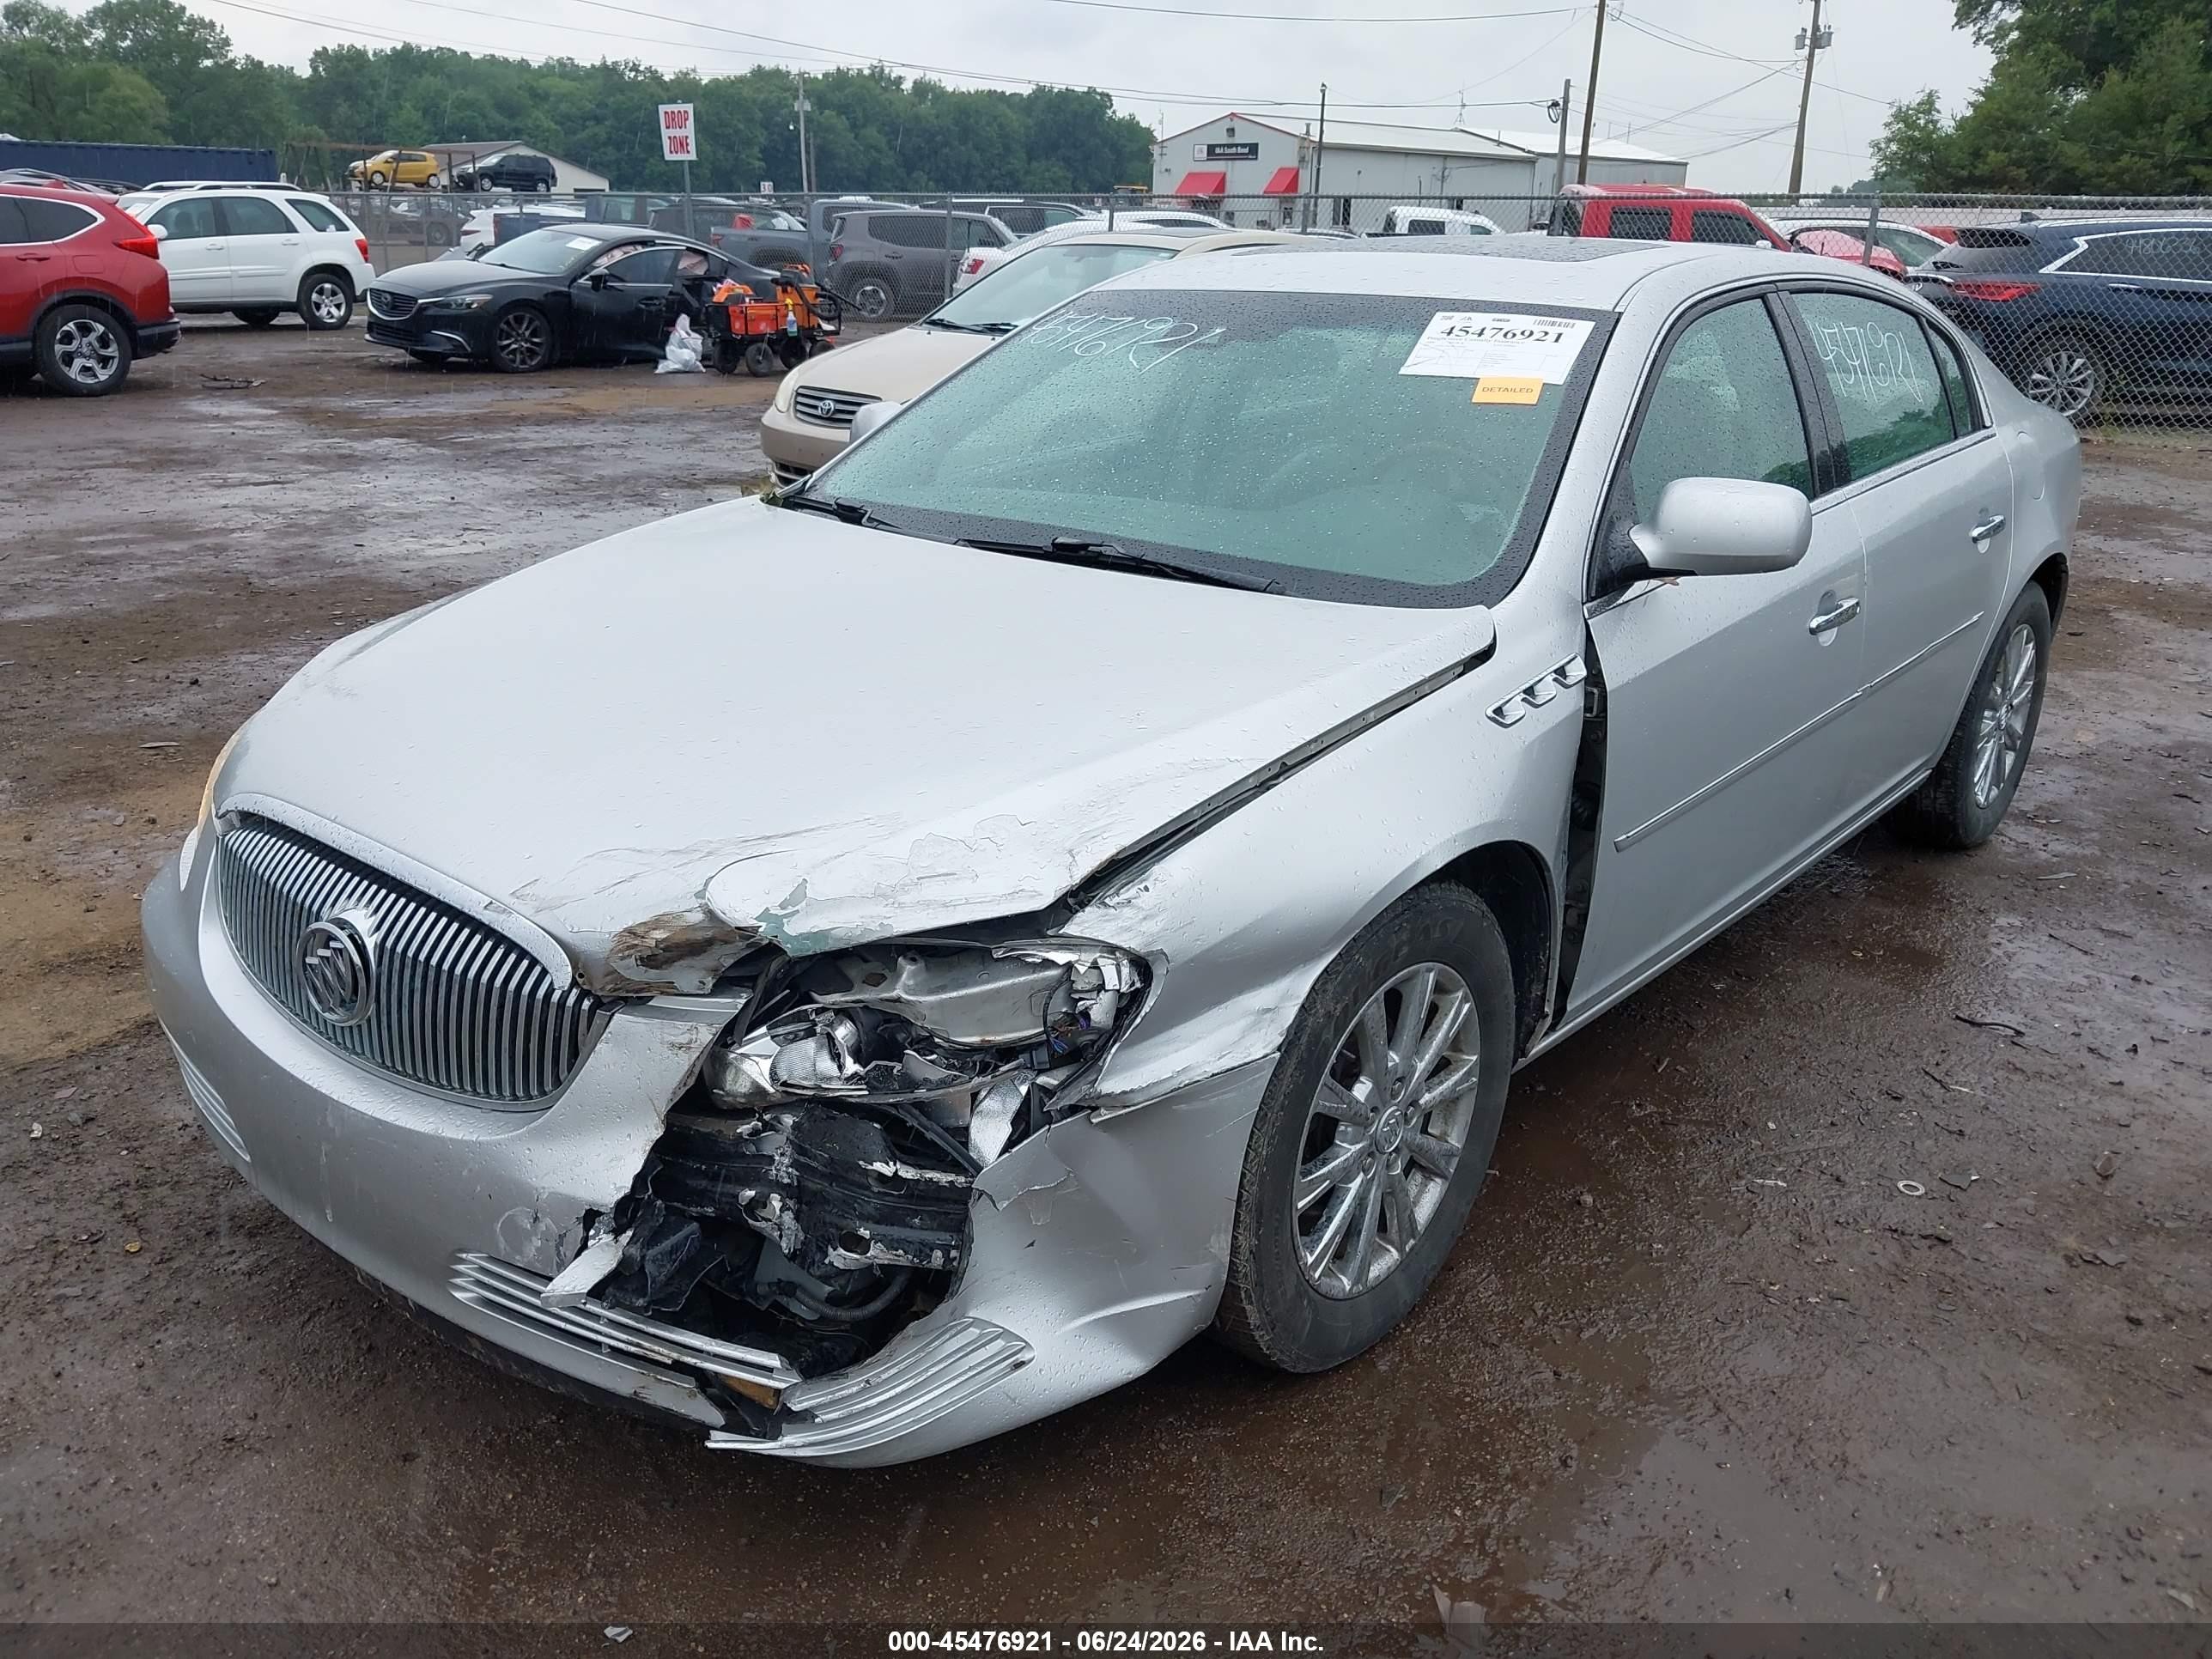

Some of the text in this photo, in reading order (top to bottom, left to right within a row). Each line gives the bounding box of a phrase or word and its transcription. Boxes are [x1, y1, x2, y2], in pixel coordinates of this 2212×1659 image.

[664, 110, 689, 130] DROP
[668, 136, 690, 155] ZONE
[1440, 325, 1564, 343] 45476921
